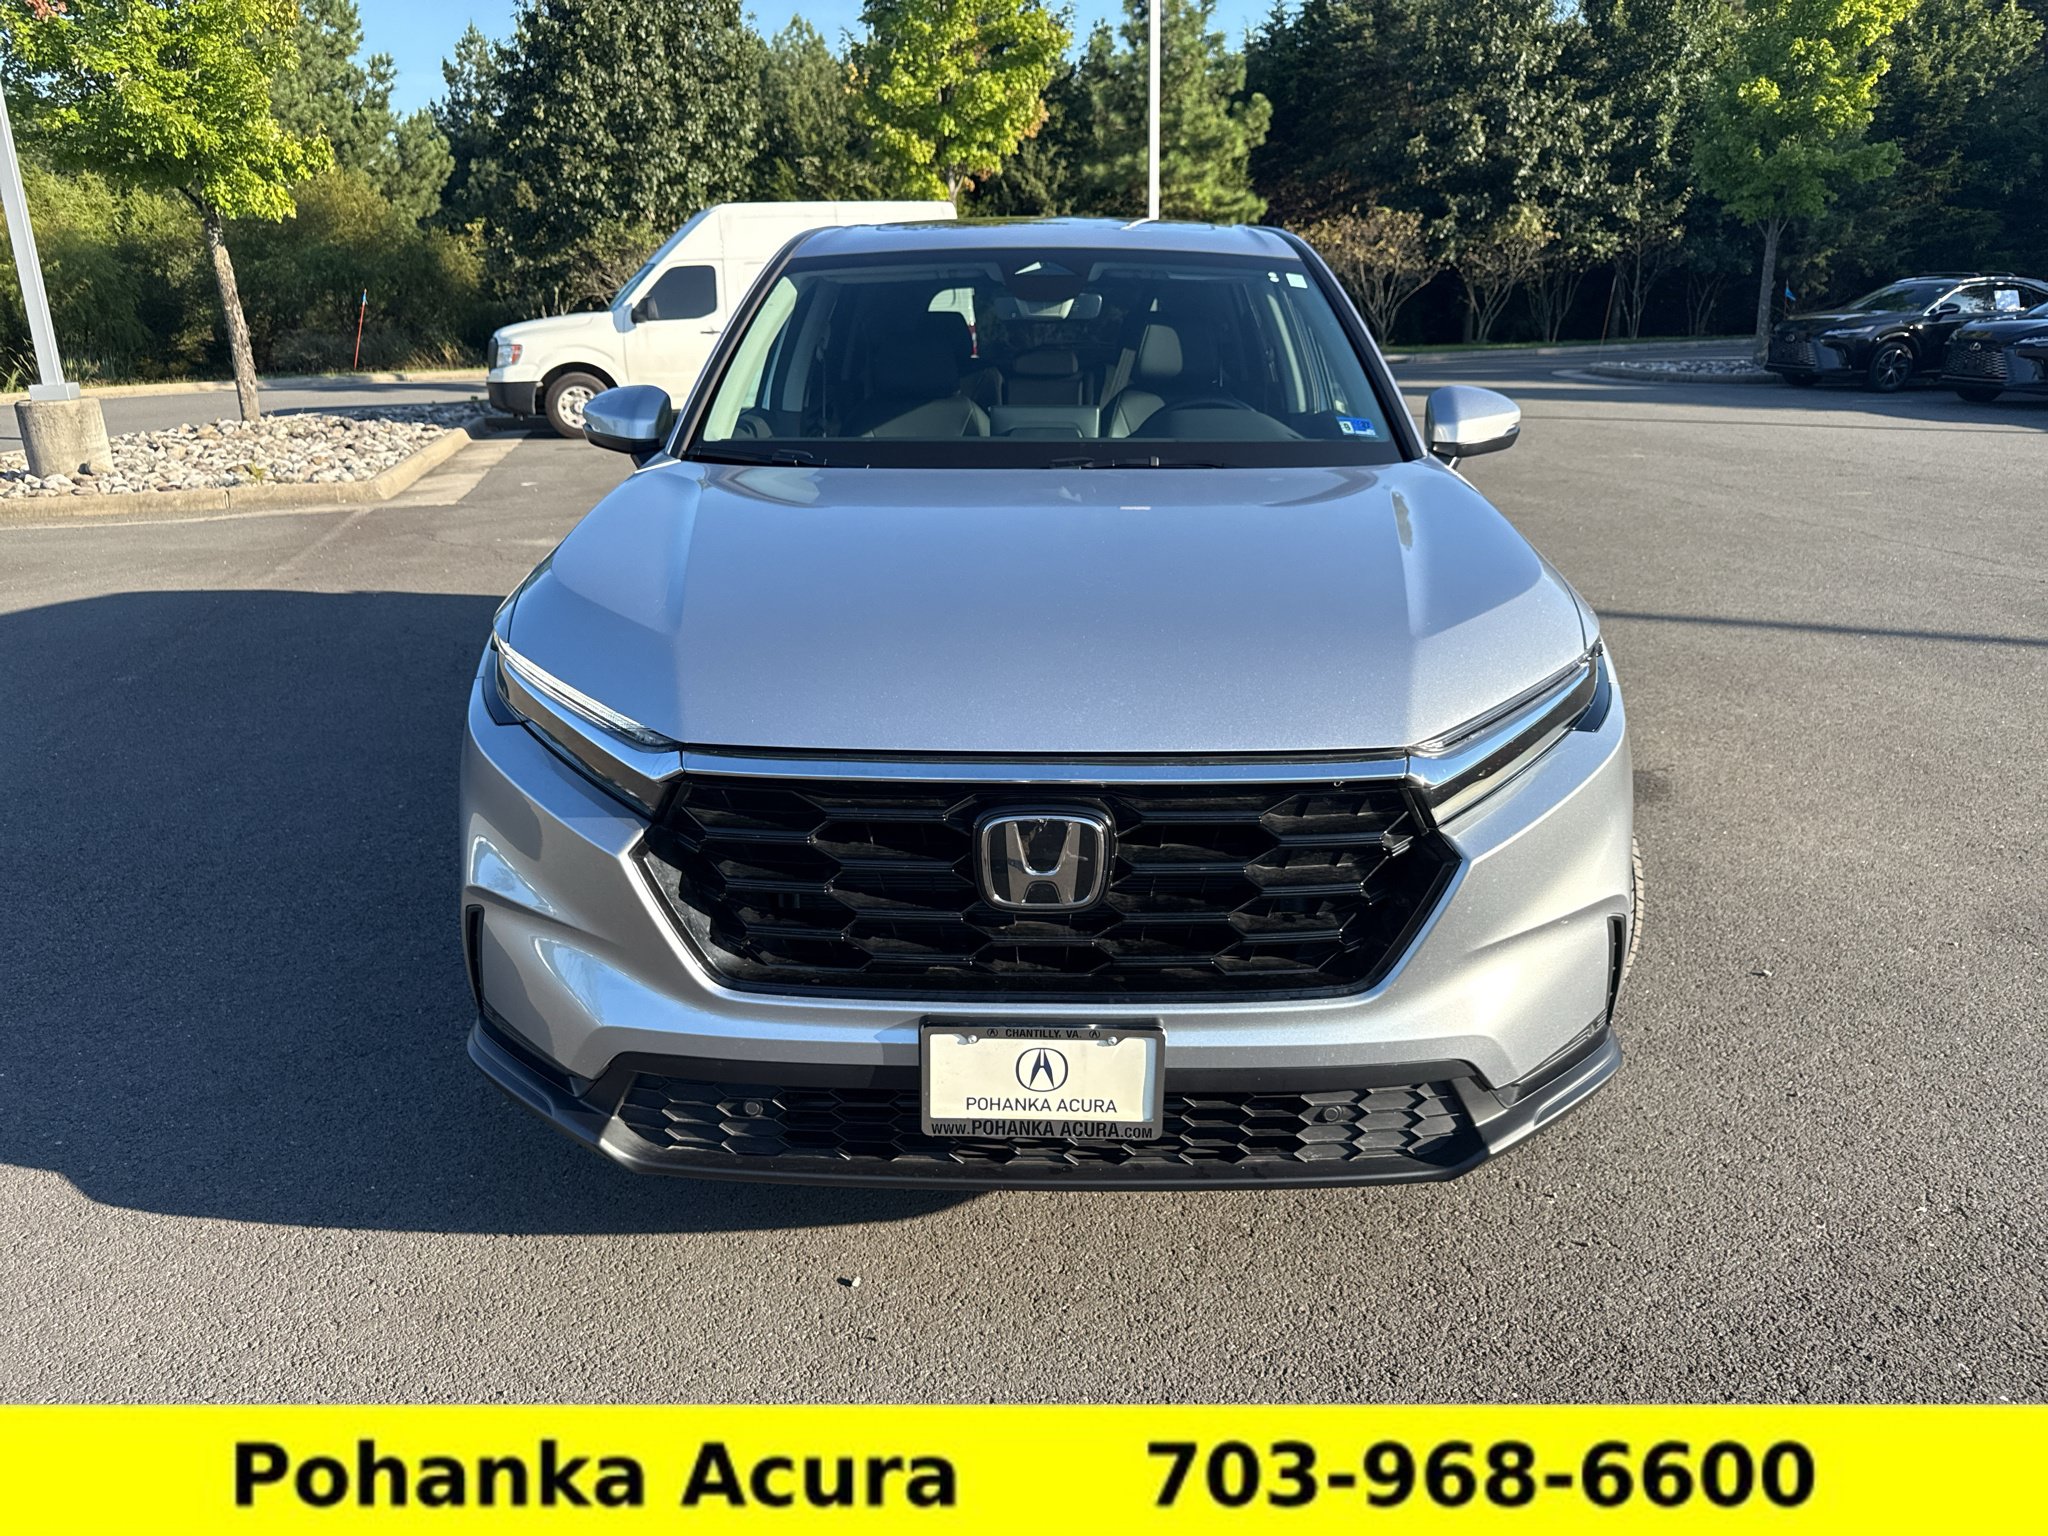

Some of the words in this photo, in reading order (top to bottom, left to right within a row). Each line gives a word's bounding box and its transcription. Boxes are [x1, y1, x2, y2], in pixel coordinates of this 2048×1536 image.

[1066, 1029, 1082, 1039] VA.
[966, 1097, 1052, 1111] POHANKA
[1056, 1098, 1117, 1113] ACURA
[1060, 1121, 1152, 1138] ACURA.COM
